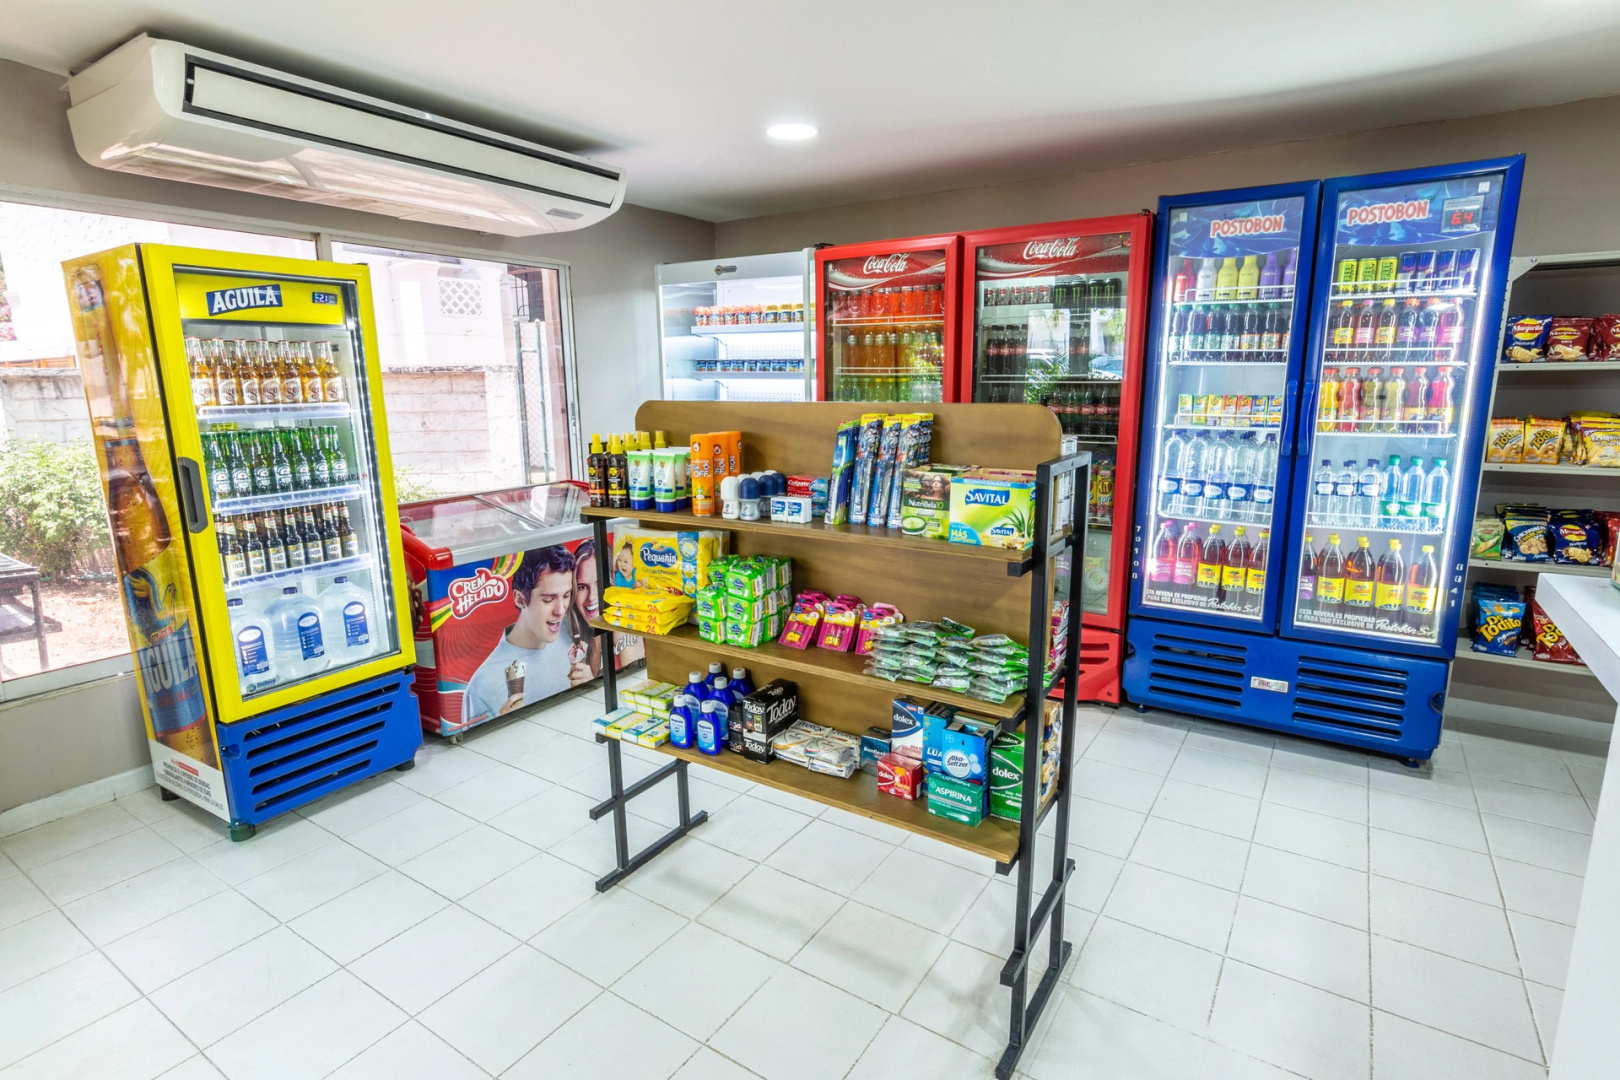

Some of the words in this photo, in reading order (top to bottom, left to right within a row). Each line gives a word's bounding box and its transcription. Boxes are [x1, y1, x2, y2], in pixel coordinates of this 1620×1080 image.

[1346, 200, 1429, 226] POSTOBON
[1210, 215, 1284, 238] POSTOBON
[1022, 237, 1080, 260] Coca-Cola
[863, 253, 910, 275] Coca-Cola
[212, 285, 279, 314] AGUILA
[1512, 324, 1544, 333] Margarita
[788, 479, 810, 487] Colgate
[965, 489, 1007, 505] SAVITAL
[951, 528, 968, 538] MÁS
[452, 573, 486, 598] CREM
[456, 580, 504, 614] HELADO
[1156, 589, 1173, 598] NEVERA
[1181, 591, 1208, 601] PROPIEDAD
[1172, 597, 1199, 607] EXCLUSIVO
[1303, 614, 1319, 622] PARA
[1332, 617, 1364, 628] EXCLUSIVO
[1313, 610, 1334, 619] NEVERA
[1343, 613, 1376, 623] PROPIEDAD
[1478, 618, 1522, 642] Todito
[743, 700, 765, 714] Today
[767, 695, 797, 724] Today
[893, 713, 914, 726] dolex
[744, 739, 766, 753] Today
[946, 760, 969, 769] Seltzer
[878, 771, 894, 780] dolex
[992, 766, 1020, 781] dolex
[935, 786, 973, 804] ASPIRINA
